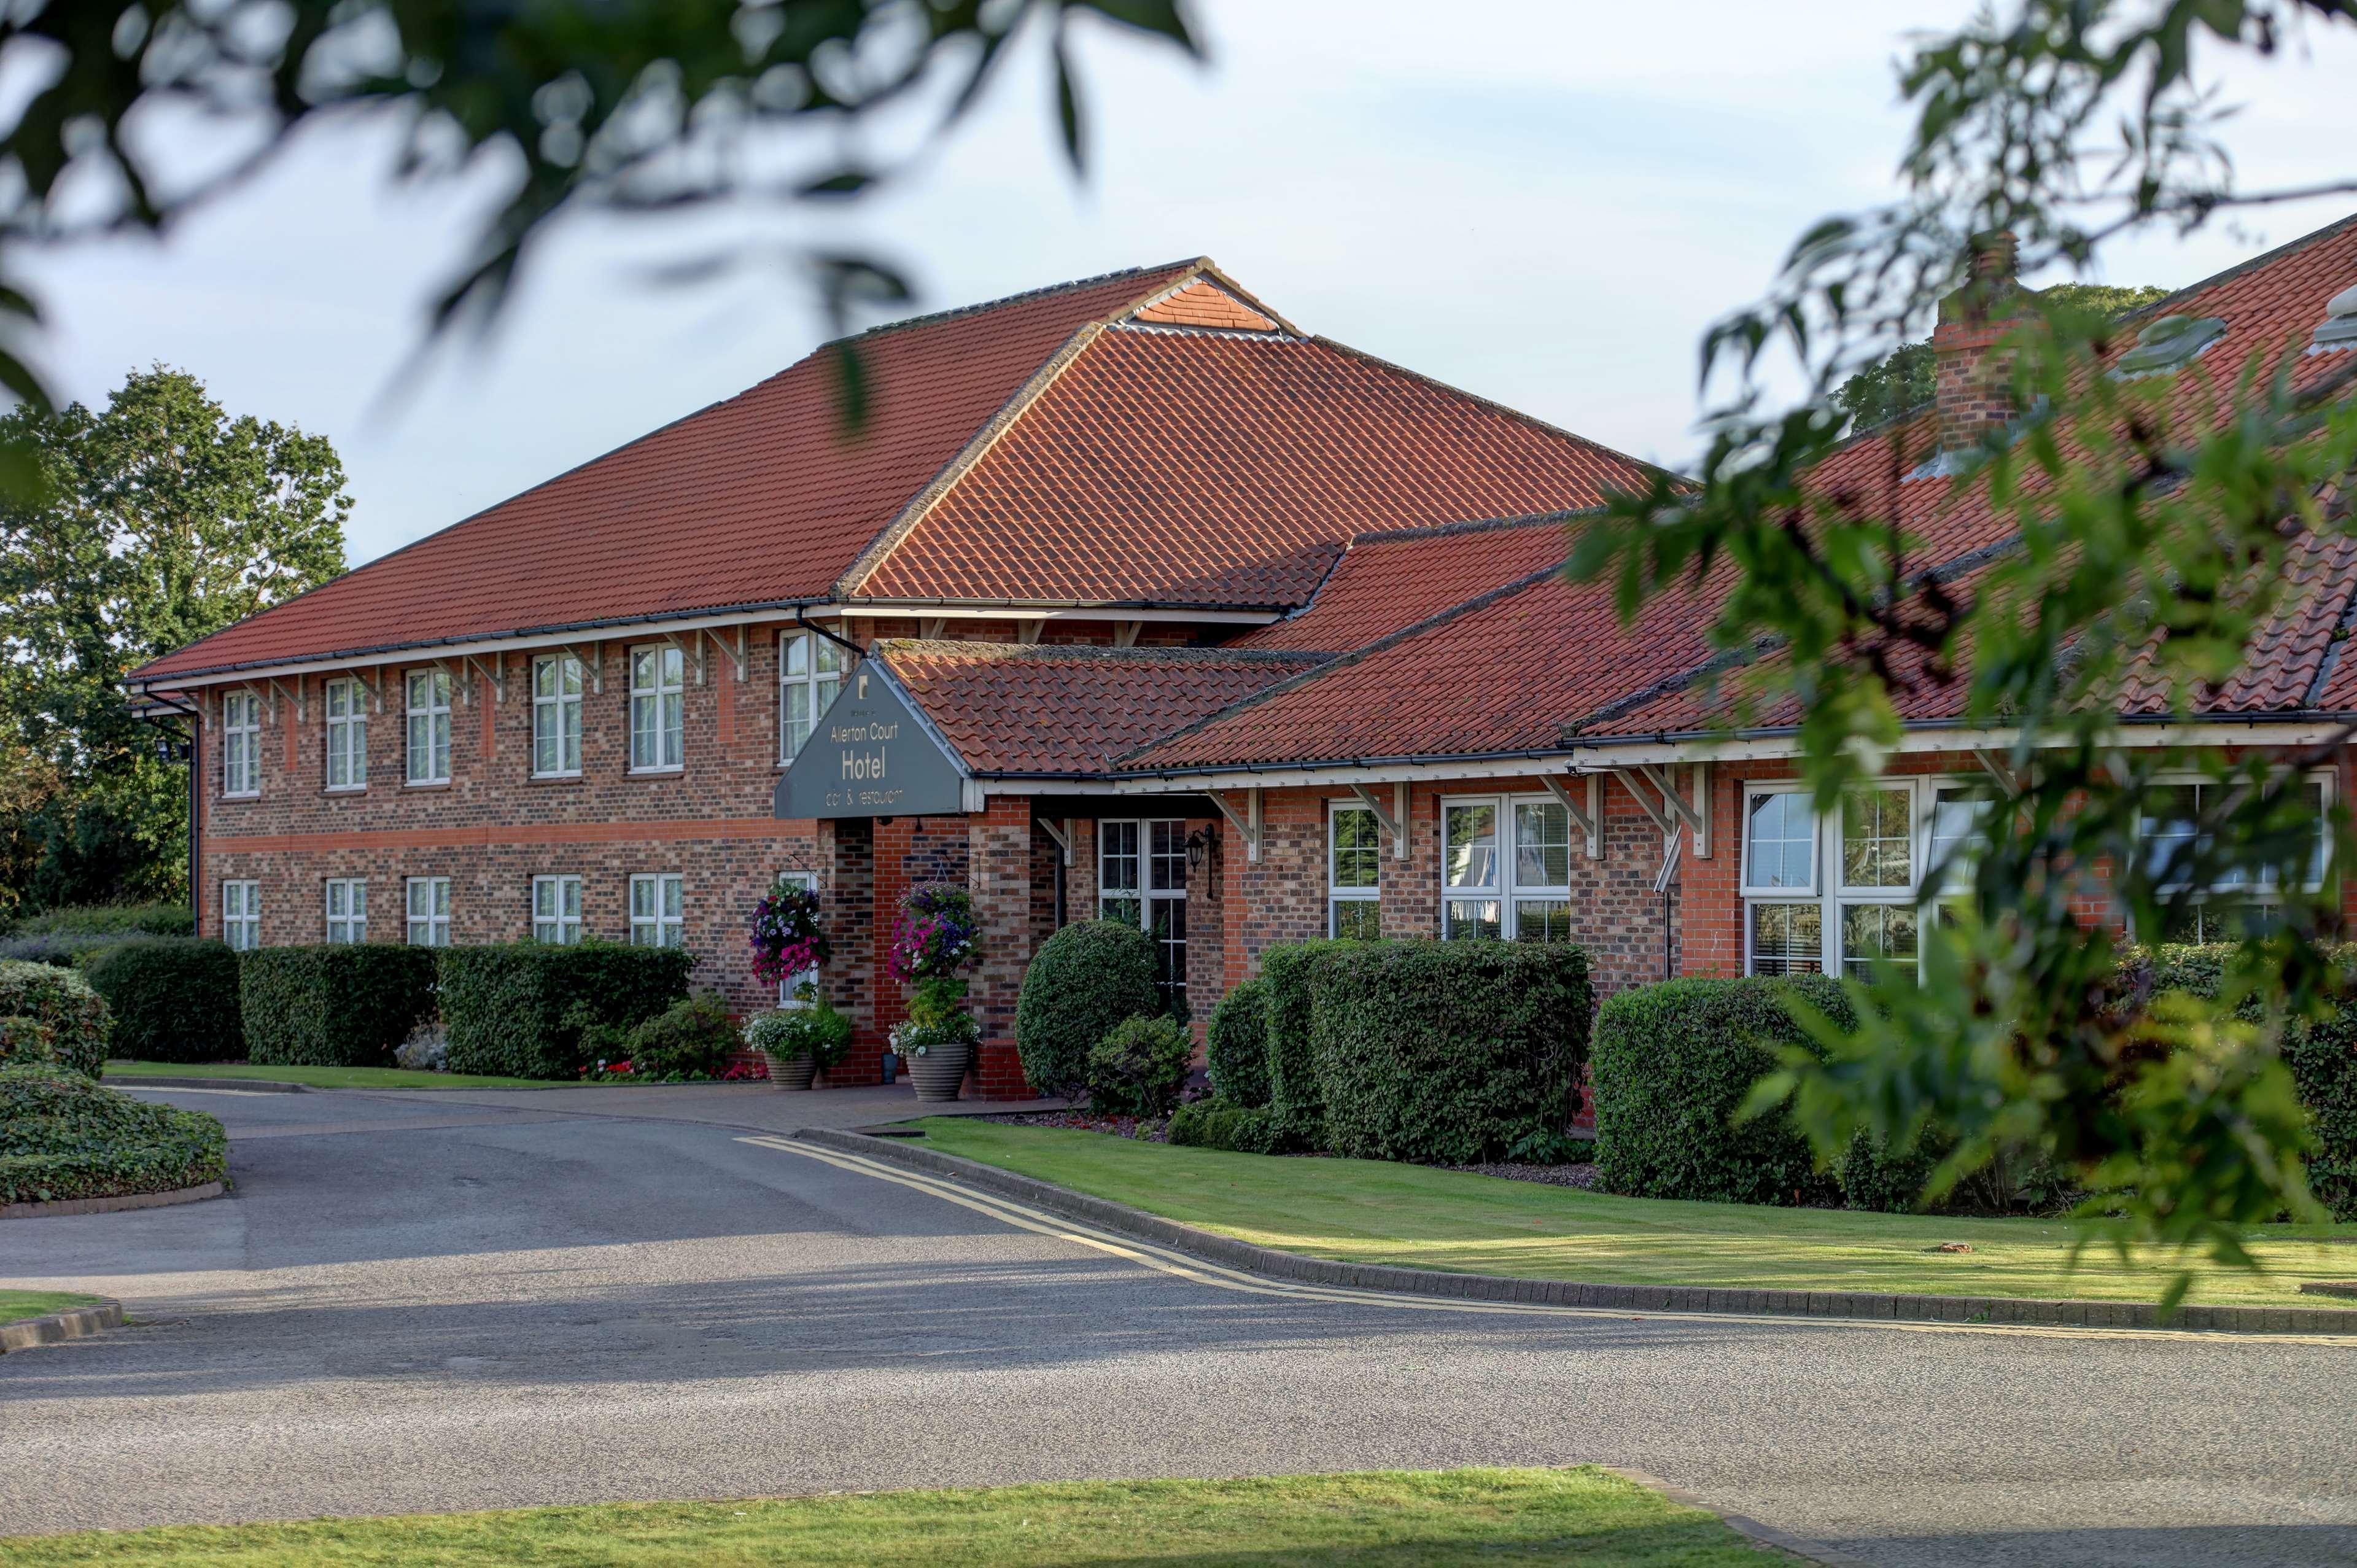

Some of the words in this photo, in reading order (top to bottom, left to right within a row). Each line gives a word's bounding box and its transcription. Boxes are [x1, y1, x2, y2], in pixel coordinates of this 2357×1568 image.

[831, 725, 866, 743] Allerton
[869, 721, 898, 740] Court
[842, 746, 885, 780] Hotel
[847, 788, 853, 805] &
